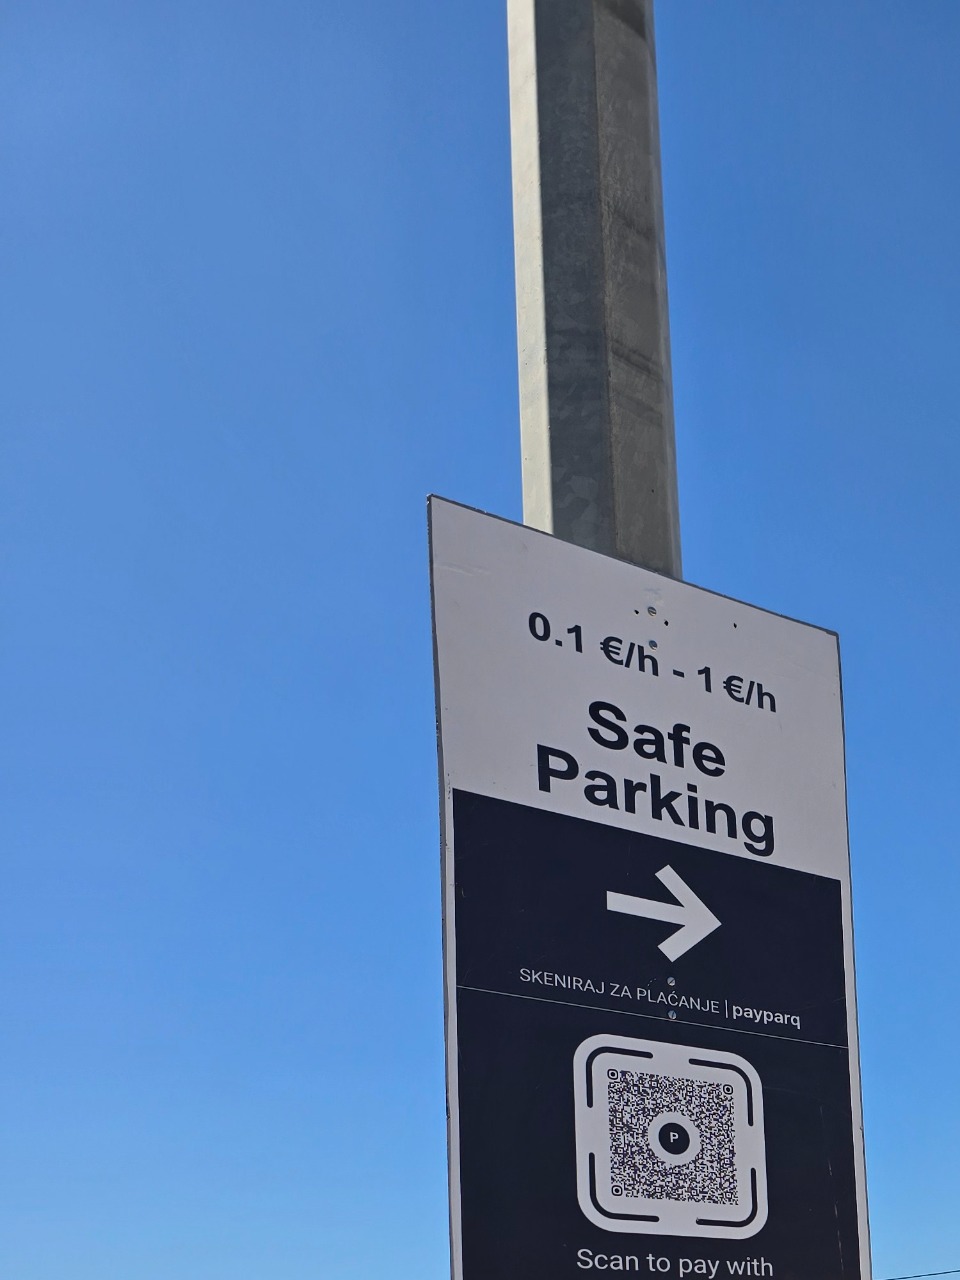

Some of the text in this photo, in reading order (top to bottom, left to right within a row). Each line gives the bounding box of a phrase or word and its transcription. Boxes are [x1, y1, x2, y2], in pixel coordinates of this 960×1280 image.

[529, 612, 582, 653] 0.1
[600, 635, 659, 677] €/h
[673, 670, 684, 678] -
[587, 700, 726, 777] Safe
[536, 743, 775, 857] Parking
[519, 967, 720, 1015] SKENIRAJ ZA PLAĆANJE
[732, 1002, 800, 1030] payparq
[670, 1132, 678, 1142] P
[577, 1249, 772, 1279] Scan to pay with
